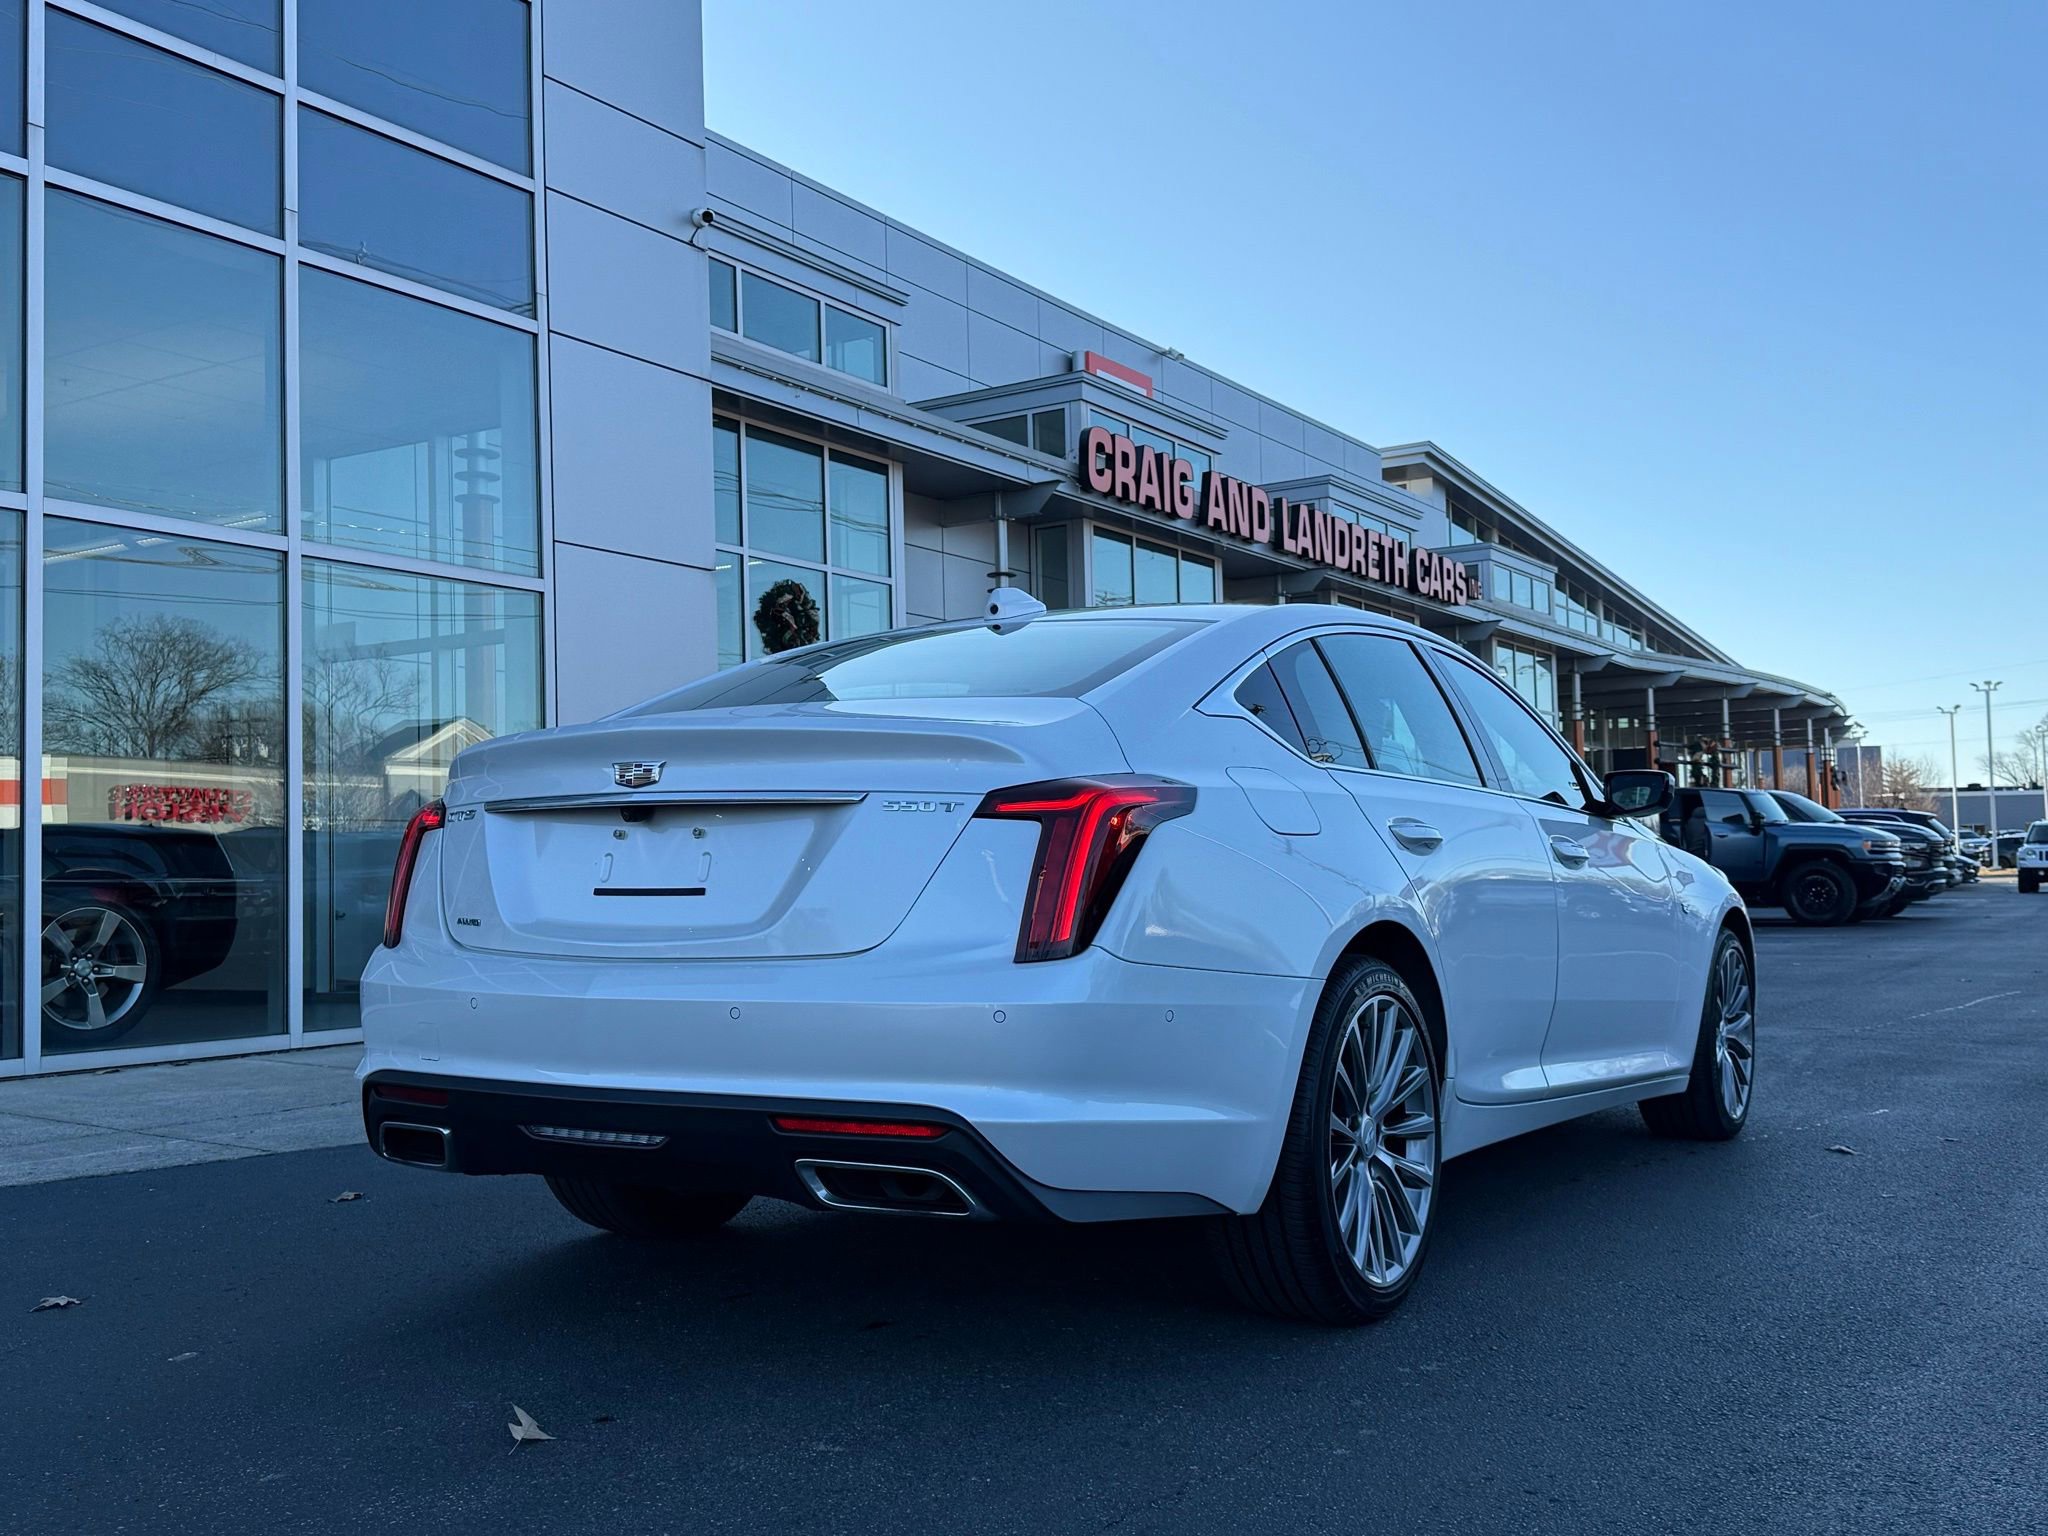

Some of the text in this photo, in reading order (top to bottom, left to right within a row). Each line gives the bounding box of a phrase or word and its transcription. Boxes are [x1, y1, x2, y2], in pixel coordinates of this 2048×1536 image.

[1086, 425, 1195, 520] CRAIG
[1207, 470, 1271, 544] AND
[1281, 496, 1409, 589] LANDRETH
[1415, 547, 1468, 606] CARS
